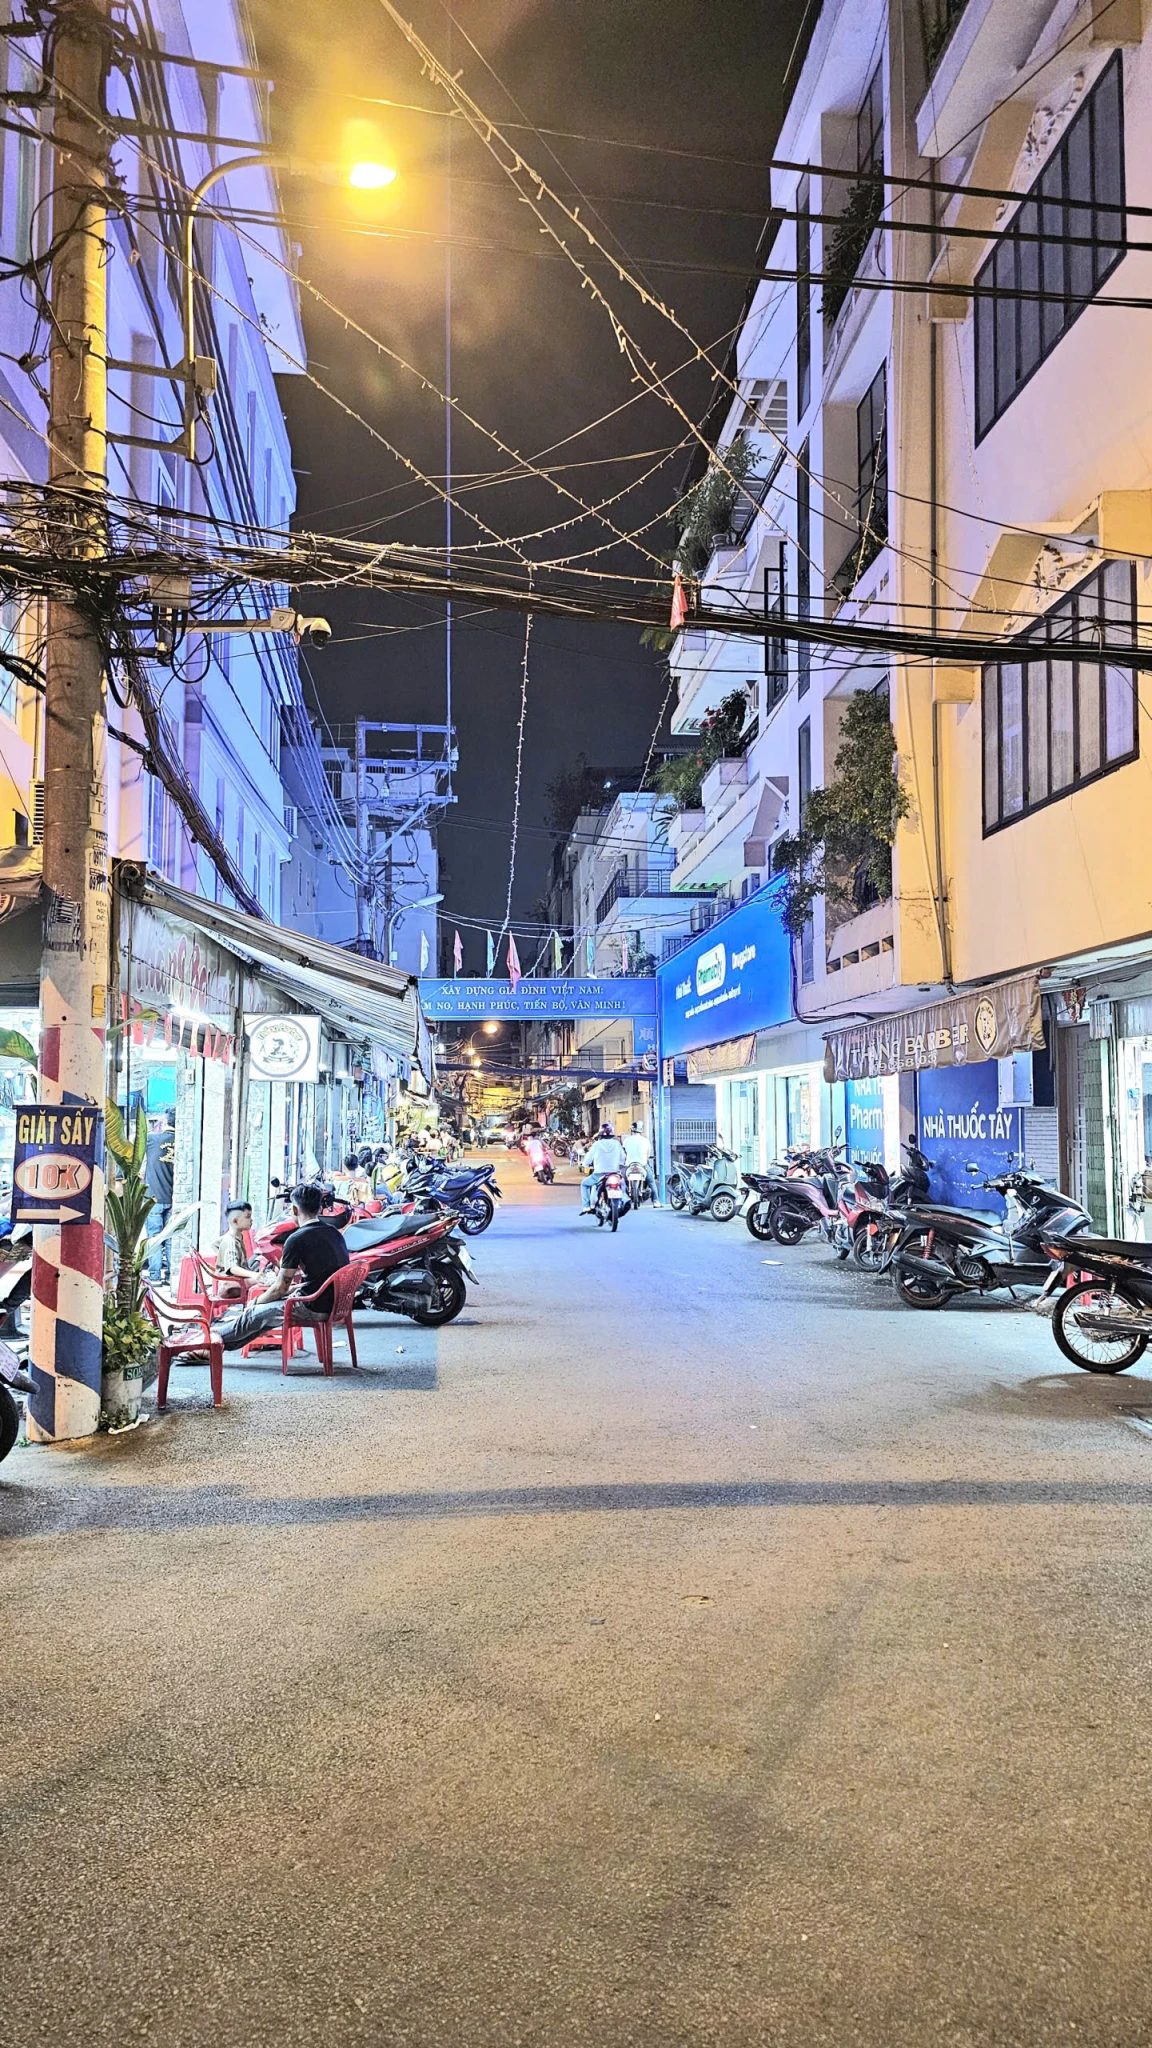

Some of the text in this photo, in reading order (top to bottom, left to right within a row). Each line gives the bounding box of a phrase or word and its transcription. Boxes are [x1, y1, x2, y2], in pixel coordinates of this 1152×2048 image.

[437, 1001, 454, 1011] NO,
[457, 1001, 486, 1012] HẠNH
[490, 999, 520, 1011] PHÚC,
[524, 998, 547, 1010] TIẾN
[552, 1000, 568, 1011] BỘ,
[571, 999, 591, 1010] VĂN
[441, 984, 604, 997] XÂY DỰNG GIA ĐÌNH VIỆT NAM:
[904, 1023, 970, 1057] BARBER
[18, 1107, 94, 1151] GIẶT SẤY
[923, 1101, 1013, 1139] NHÀ THUỐC TÂY
[25, 1164, 82, 1190] 10K
